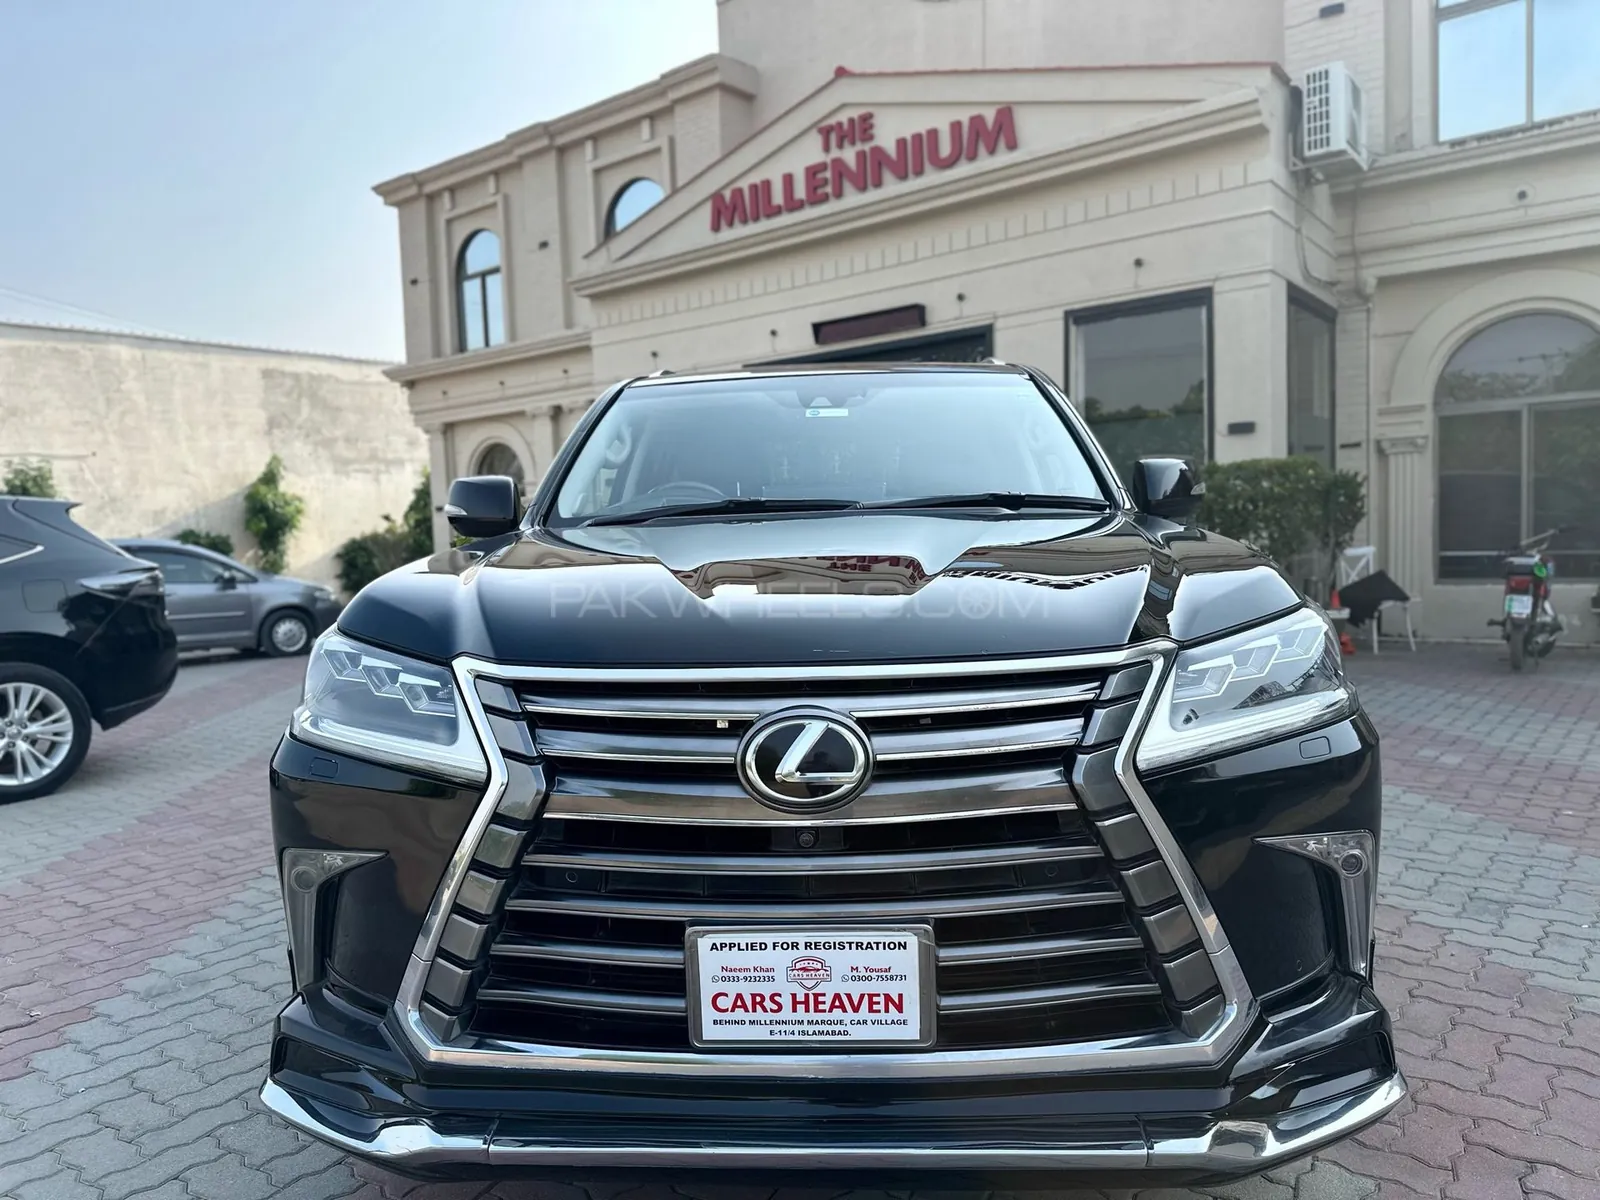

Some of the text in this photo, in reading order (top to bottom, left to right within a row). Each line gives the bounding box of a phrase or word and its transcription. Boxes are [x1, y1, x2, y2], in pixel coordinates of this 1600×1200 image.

[817, 112, 874, 153] THE
[711, 105, 1018, 232] MILLENNIUM
[709, 941, 907, 952] APPLIED FOR REGISTRATION
[720, 975, 776, 983] 0333-9232335
[850, 974, 907, 982] 0300-7558731
[711, 992, 904, 1014] CARS HEAVEN
[807, 1019, 848, 1027] MARQUE,
[769, 1029, 852, 1037] E-11/4 ISLAMABAD.
